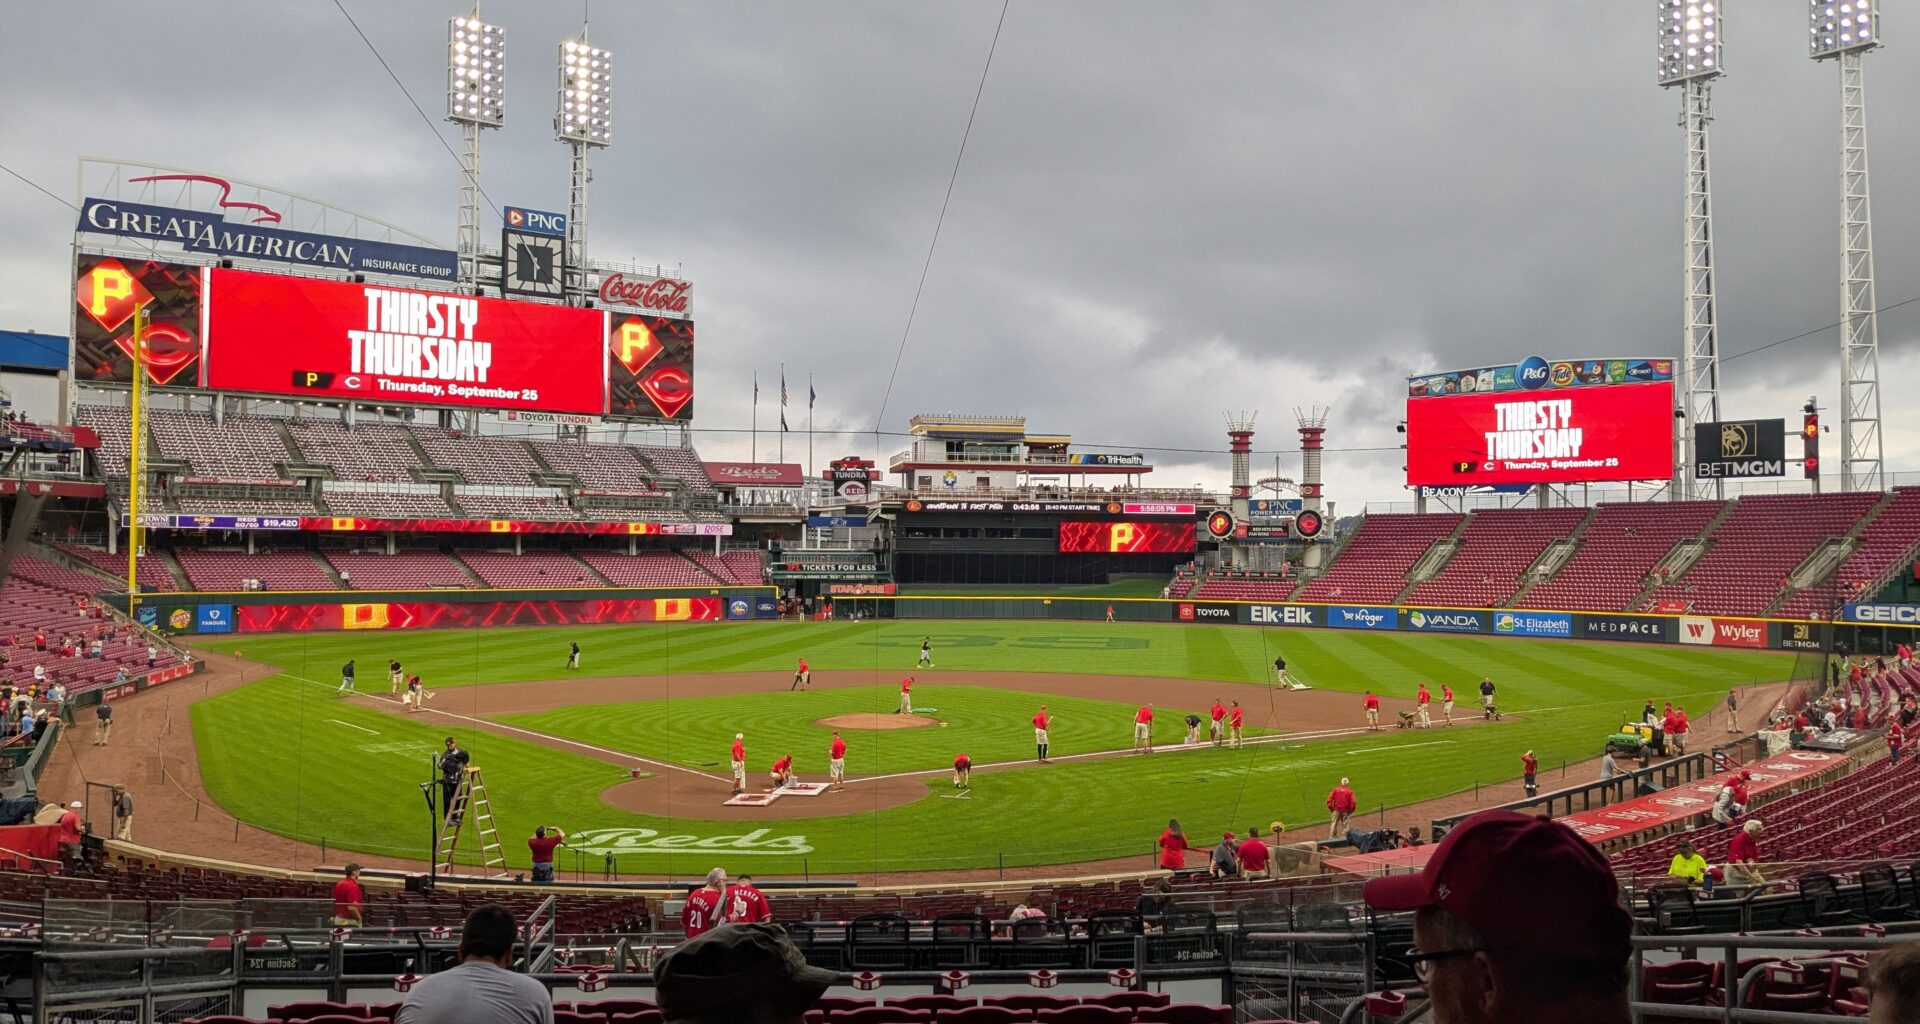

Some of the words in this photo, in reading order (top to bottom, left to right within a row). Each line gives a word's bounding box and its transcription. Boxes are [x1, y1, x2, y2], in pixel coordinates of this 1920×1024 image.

[526, 212, 565, 232] PNC
[87, 203, 203, 240] GREAT
[192, 224, 355, 265] AMERICAN
[362, 258, 417, 273] INSURANCE
[419, 263, 453, 278] GROUP
[600, 272, 692, 312] Coca-Cola
[364, 288, 478, 341] THIRSTY
[347, 330, 492, 384] THURSDAY
[1523, 367, 1547, 380] P&G
[377, 377, 445, 397] Thursday,
[447, 383, 520, 401] September
[521, 388, 538, 401] 25
[520, 412, 555, 422] TOYOTA
[557, 414, 593, 425] TUNDRA
[1494, 400, 1572, 432] THIRSTY
[1485, 429, 1583, 461] THURSDAY
[1106, 455, 1142, 465] TriHealth
[1504, 460, 1549, 471] Thursday,
[1551, 458, 1604, 470] September
[1606, 458, 1619, 467] 25
[834, 471, 867, 480] TUNDRA
[1698, 460, 1781, 477] BETMGM
[1422, 486, 1465, 498] BEACON
[1269, 501, 1293, 510] PNC
[263, 517, 298, 527] $19,420
[1196, 608, 1231, 617] TOYOTA
[1354, 608, 1384, 627] Kroger
[1425, 614, 1480, 627] VANDA
[1855, 605, 1920, 622] GEIC
[1526, 617, 1569, 630] Elizabeth
[1588, 621, 1660, 635] MEDPACE
[1687, 623, 1706, 638] W
[1719, 623, 1761, 640] Wyler
[1782, 640, 1820, 650] BETMGM
[562, 828, 815, 856] Reds
[690, 910, 702, 929] 20
